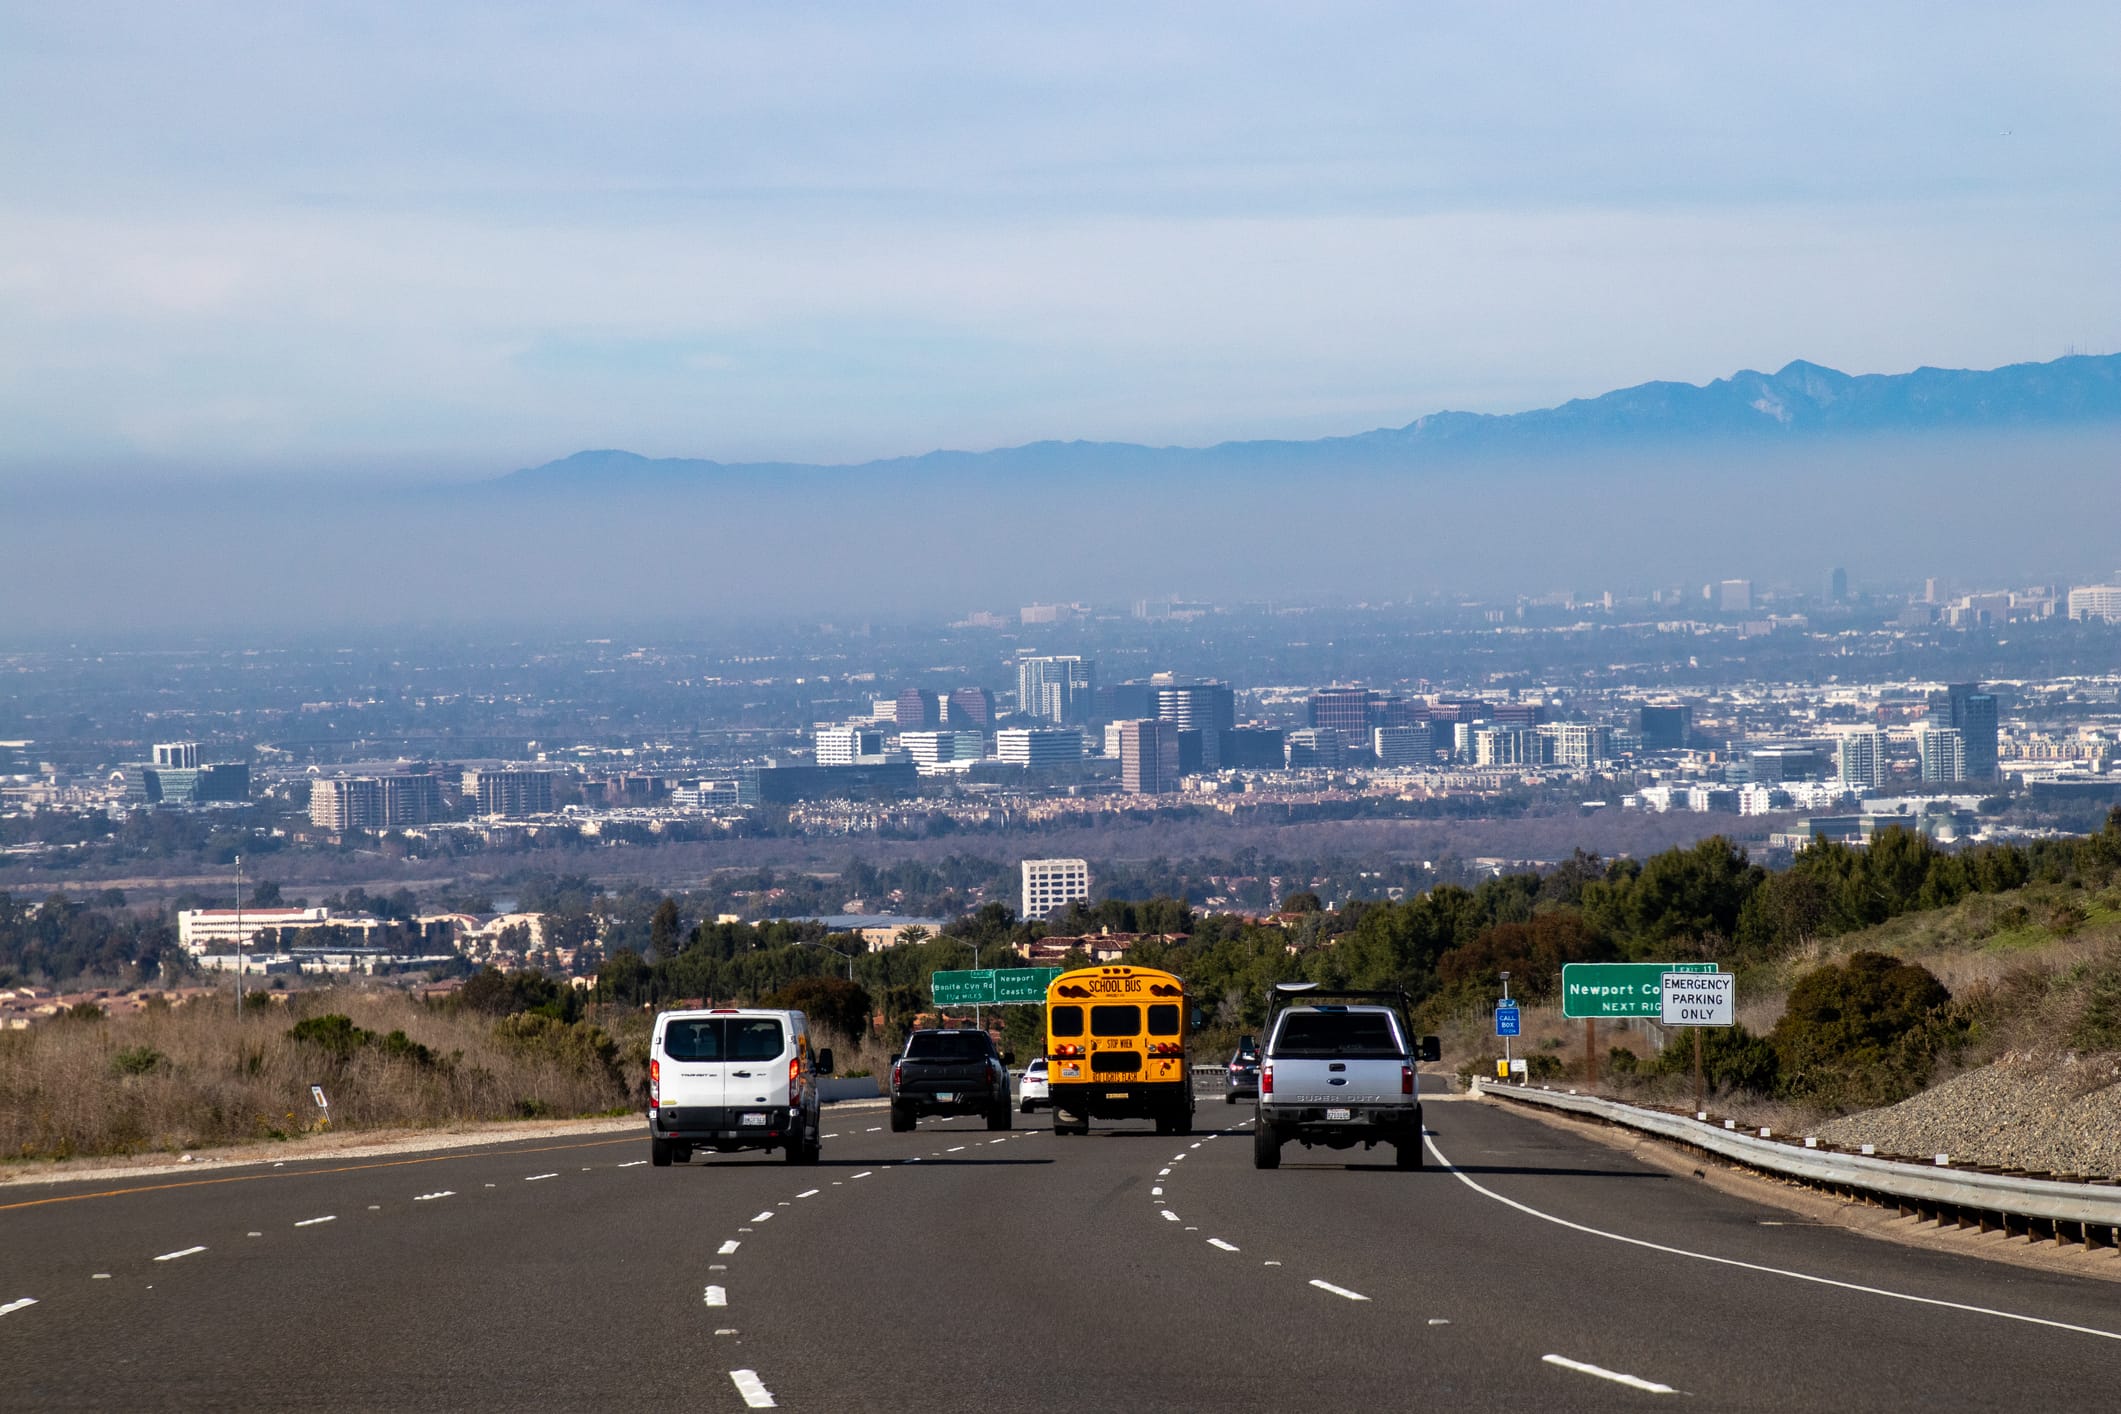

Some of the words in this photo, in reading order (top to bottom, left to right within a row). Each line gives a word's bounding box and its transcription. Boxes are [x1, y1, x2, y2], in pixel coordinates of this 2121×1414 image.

[1089, 980, 1122, 992] SCHOOL
[1125, 980, 1141, 992] BUS
[1664, 978, 1730, 990] EMERGENCY
[1570, 983, 1633, 997] Newport
[1642, 983, 1661, 995] Co
[1672, 994, 1723, 1005] PARKING
[1602, 1002, 1636, 1011] NEXT
[1641, 1002, 1662, 1011] RIG
[1681, 1009, 1714, 1020] ONLY
[1107, 1039, 1118, 1049] STOP
[1120, 1039, 1133, 1049] WHEN
